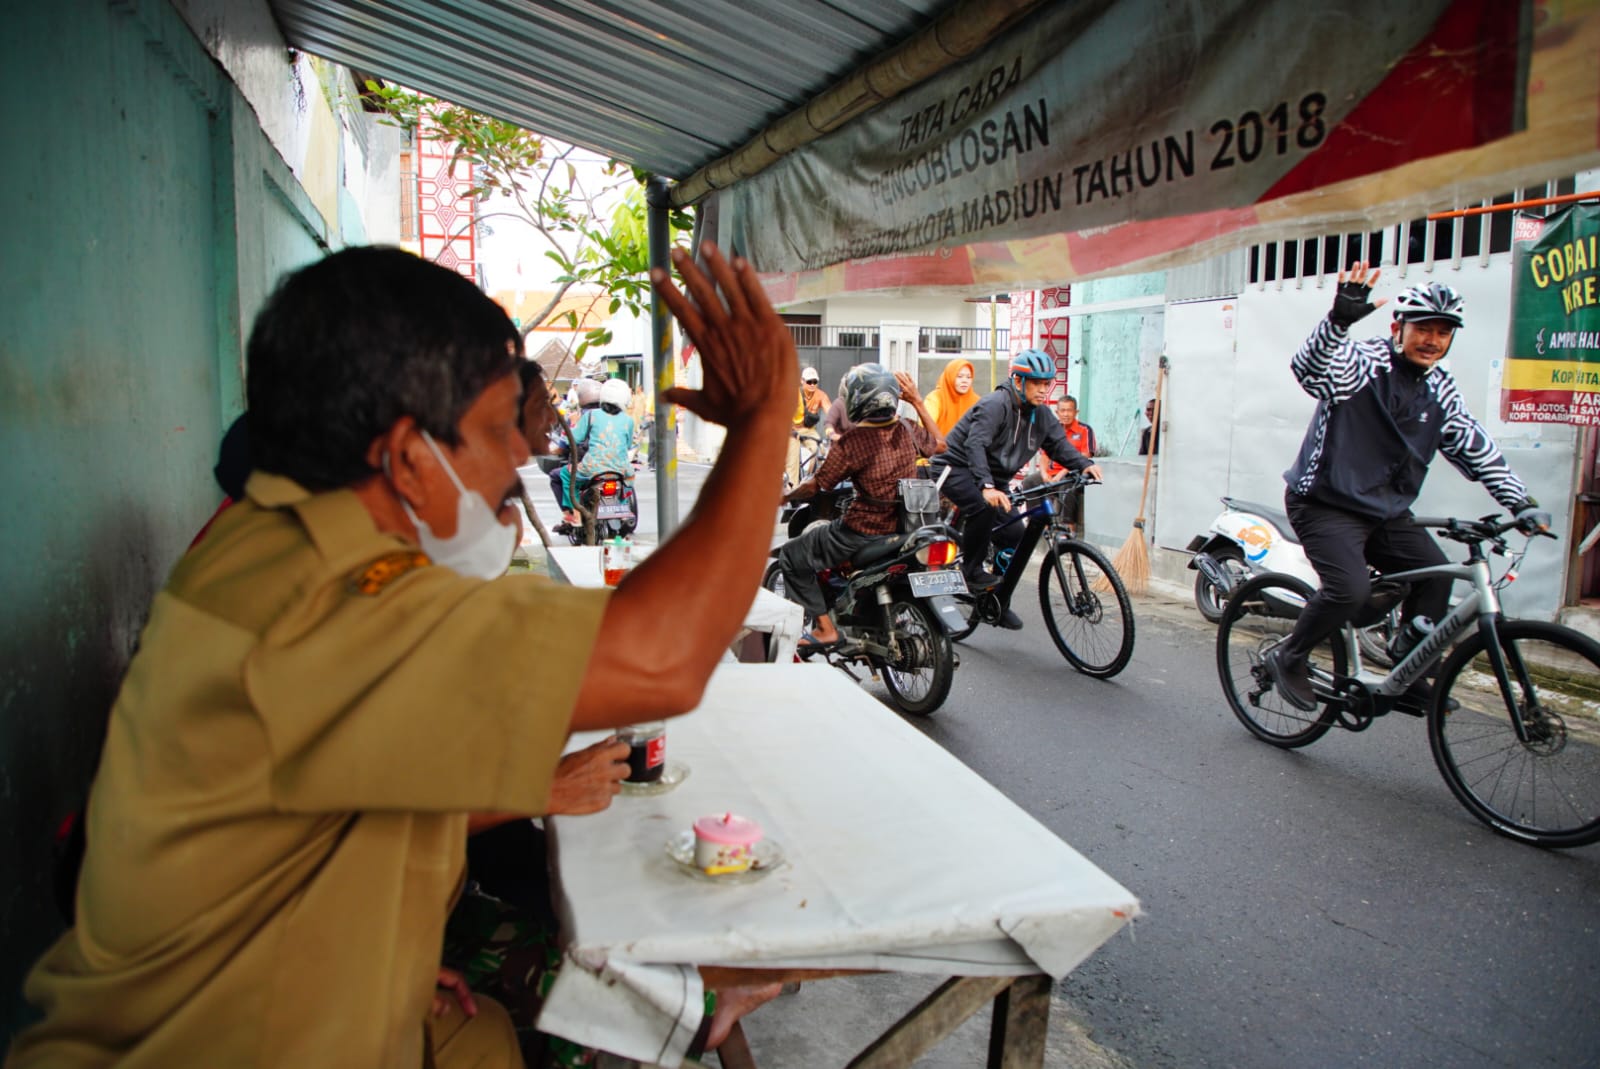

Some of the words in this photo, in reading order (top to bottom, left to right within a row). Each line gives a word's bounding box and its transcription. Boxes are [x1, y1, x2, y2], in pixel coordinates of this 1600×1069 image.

[899, 99, 946, 152] TATA
[951, 57, 1022, 123] CARA
[914, 206, 956, 248] KOTA
[961, 174, 1062, 231] MADIUN
[1072, 130, 1195, 204] TAHUN
[1209, 91, 1328, 171] 2018
[1530, 235, 1597, 289] COBAI
[1509, 412, 1530, 421] KOPI
[1512, 402, 1536, 412] NASI
[914, 576, 926, 587] AE
